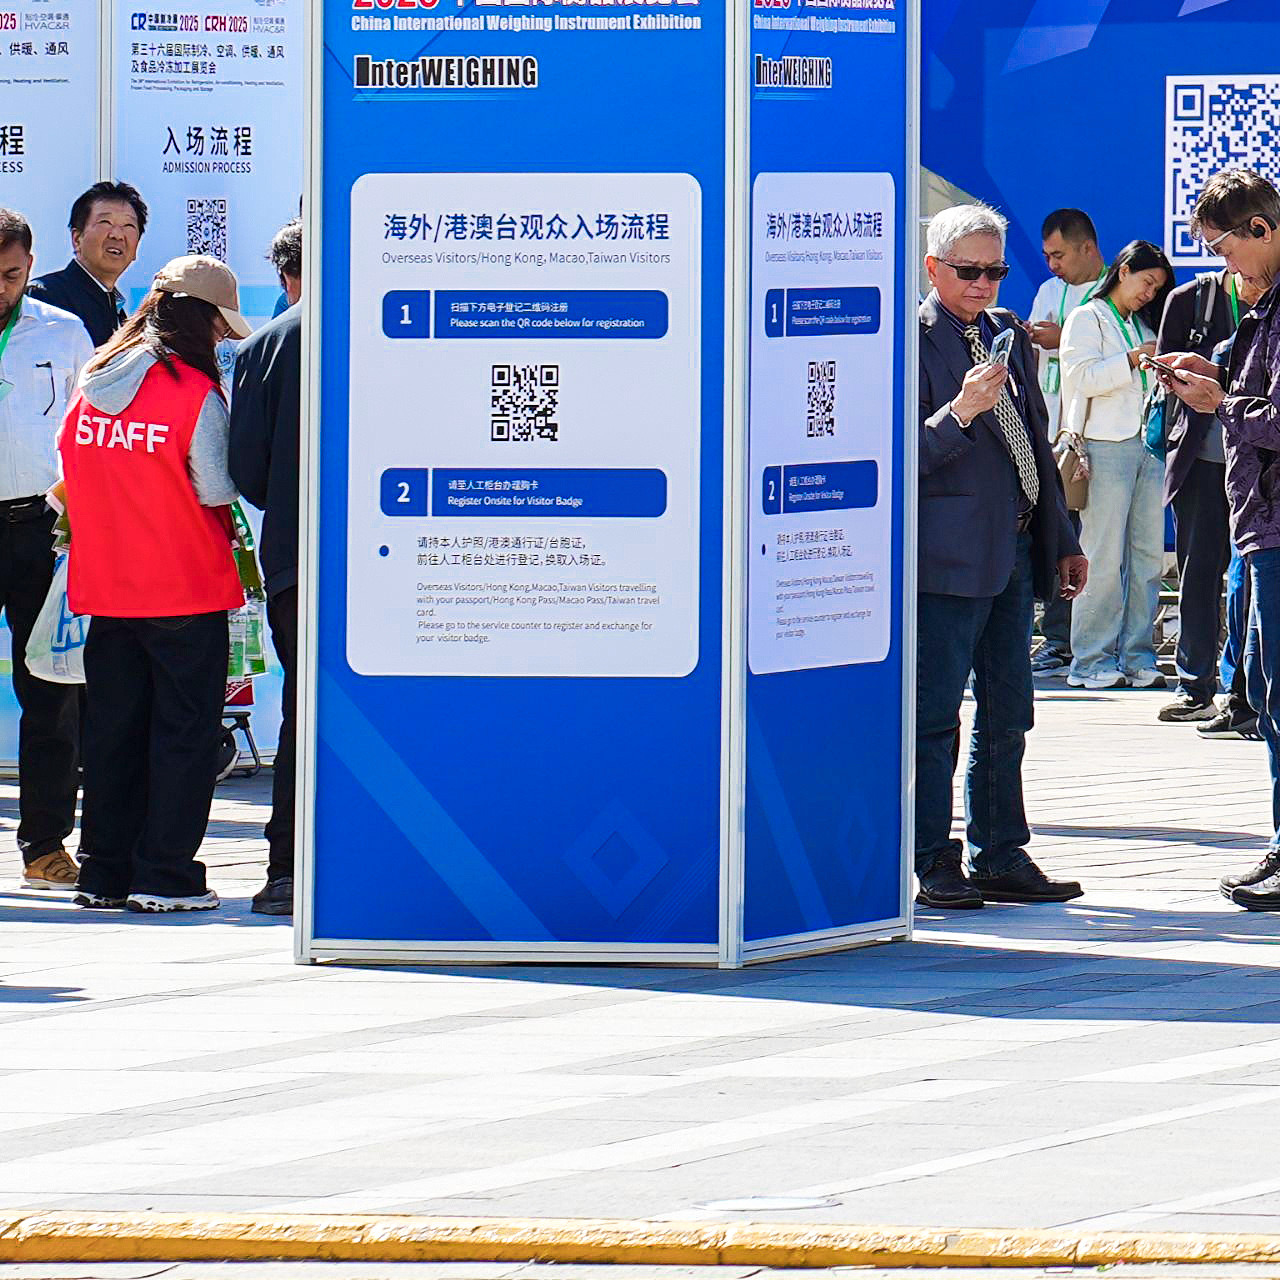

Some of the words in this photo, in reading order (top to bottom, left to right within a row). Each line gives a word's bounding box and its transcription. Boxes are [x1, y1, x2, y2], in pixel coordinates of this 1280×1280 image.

[179, 15, 199, 32] 2025
[228, 16, 248, 32] 2025
[351, 15, 392, 31] China
[393, 15, 484, 31] International
[487, 14, 553, 32] Weighing
[554, 14, 631, 31] Instrument
[633, 13, 702, 31] Exhibition
[354, 55, 539, 88] InterWEIGHING
[162, 126, 252, 156] 入场流程
[162, 161, 211, 173] ADMISSION
[212, 161, 251, 173] PROCESS
[383, 213, 670, 243] 海外/港澳台观众入场流程
[381, 252, 433, 264] Overseas
[435, 251, 512, 267] Visitors/Hong
[514, 251, 547, 266] Kong,
[629, 251, 671, 264] Visitors
[400, 304, 413, 325] 1
[771, 303, 778, 323] 1
[450, 318, 478, 327] Please
[480, 318, 500, 327] scan
[501, 318, 516, 327] the
[517, 318, 530, 328] QR
[531, 318, 553, 327] code
[553, 318, 581, 327] below
[581, 318, 594, 327] for
[596, 318, 645, 329] registration
[75, 414, 169, 453] STAFF
[397, 481, 411, 503] 2
[768, 480, 775, 501] 2
[447, 496, 482, 507] Register
[484, 496, 512, 505] Onsite
[513, 496, 525, 505] for
[526, 496, 554, 505] Visitor
[555, 496, 583, 508] Badge
[418, 621, 444, 630] Please
[466, 621, 480, 630] the
[481, 621, 510, 630] service
[511, 621, 542, 630] counter
[585, 621, 600, 630] and
[640, 621, 653, 630] for
